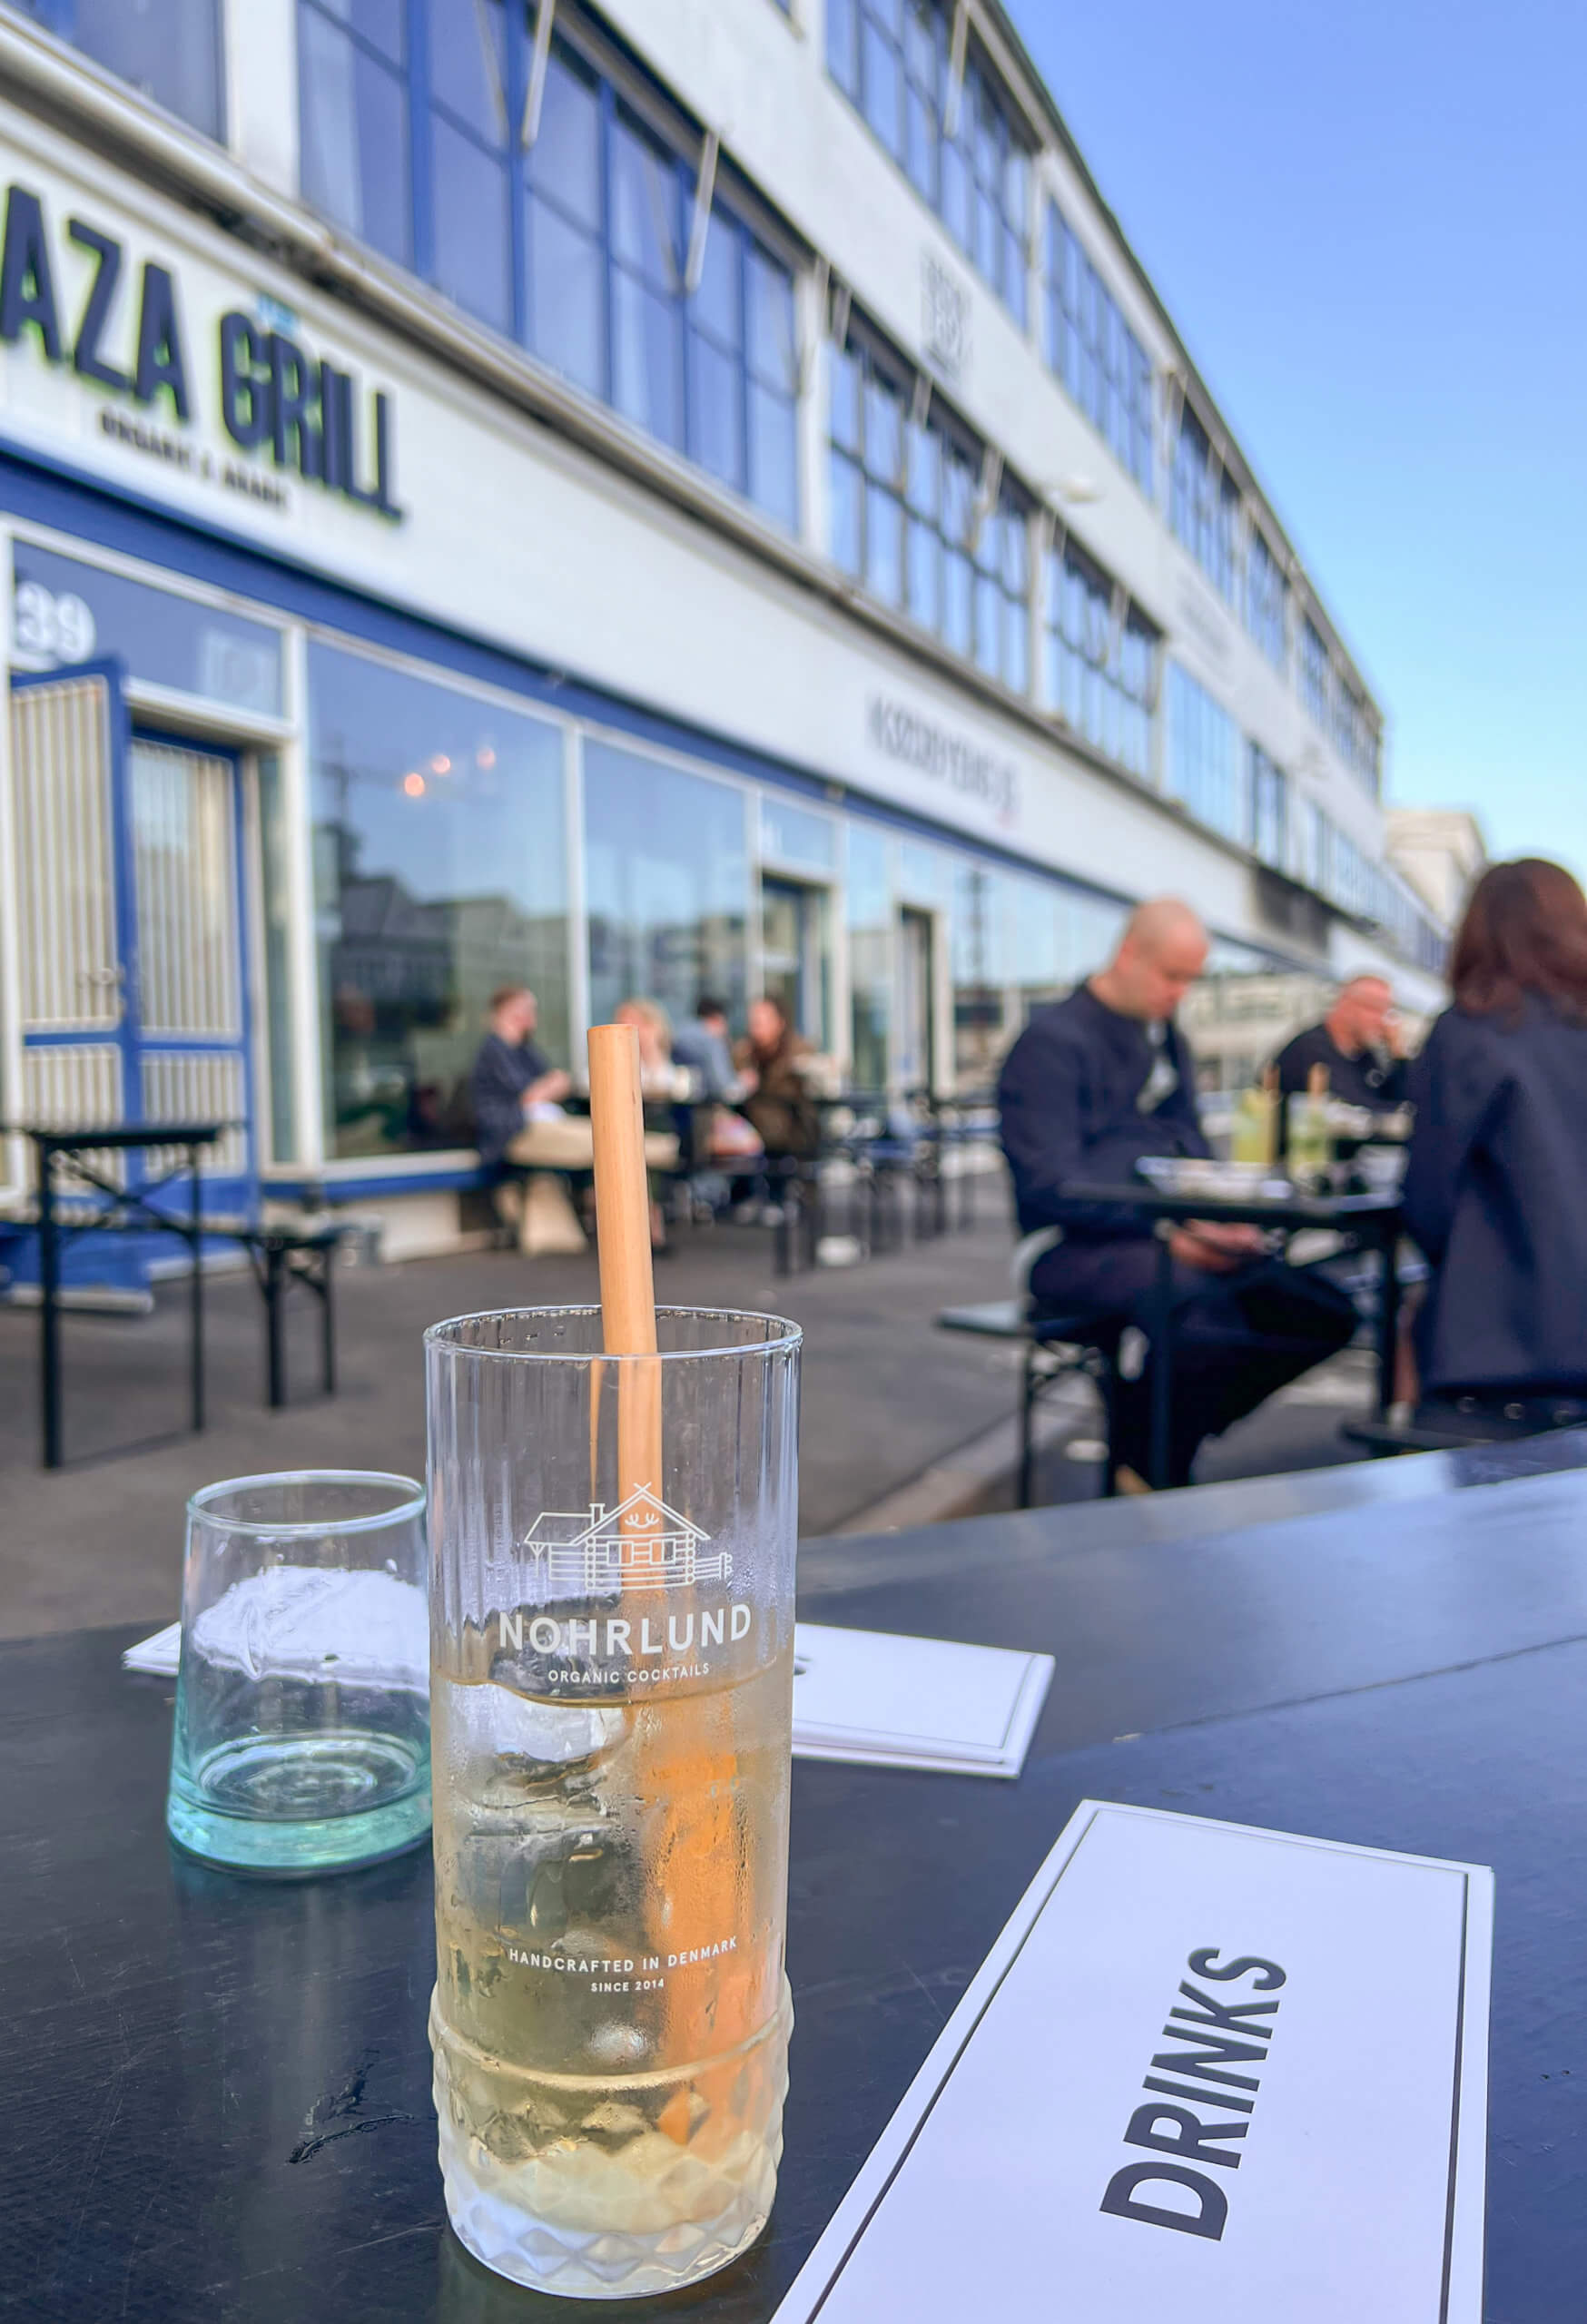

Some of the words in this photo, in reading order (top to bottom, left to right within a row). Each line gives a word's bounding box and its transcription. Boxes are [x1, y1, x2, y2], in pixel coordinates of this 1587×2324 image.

[221, 311, 403, 519] GRILL
[499, 1603, 752, 1656] NOHRLUND
[547, 1669, 620, 1684] ORGANIC
[626, 1662, 710, 1682] COCKTAILS
[508, 1947, 634, 1973] HANDCRAFTED
[642, 1956, 659, 1970] IN
[667, 1935, 737, 1967] DENMARK
[590, 1982, 629, 1993] SINCE
[635, 1977, 665, 1991] 2014
[1099, 1947, 1286, 2241] DRINKS
